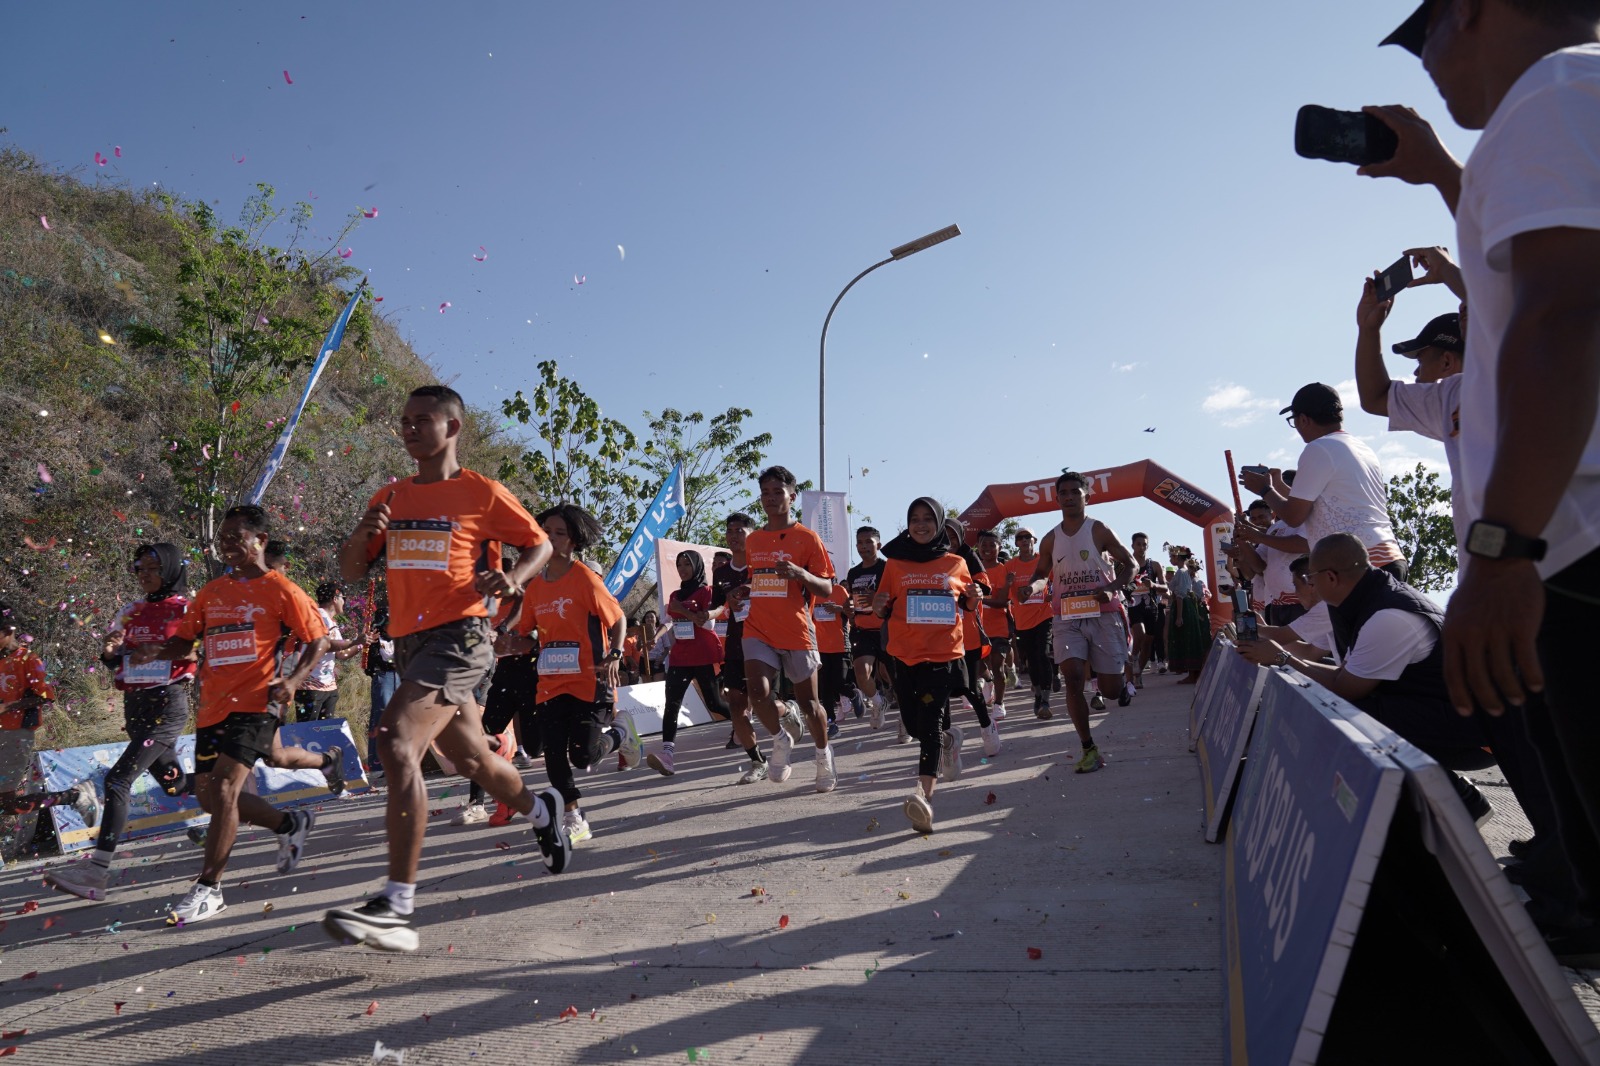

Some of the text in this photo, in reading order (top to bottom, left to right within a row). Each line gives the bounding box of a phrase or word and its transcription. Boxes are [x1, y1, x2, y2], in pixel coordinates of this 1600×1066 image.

[1023, 472, 1112, 505] STRT
[1169, 494, 1184, 505] RUN
[1173, 491, 1197, 506] SUNSET
[1177, 487, 1212, 508] GOLO MORI
[400, 538, 446, 553] 30428
[758, 578, 785, 587] 30308
[920, 602, 952, 612] 10036
[1070, 600, 1096, 610] 30518
[216, 638, 252, 651] 50814
[547, 653, 575, 664] 10050
[1244, 747, 1316, 963] ISOPLUS
